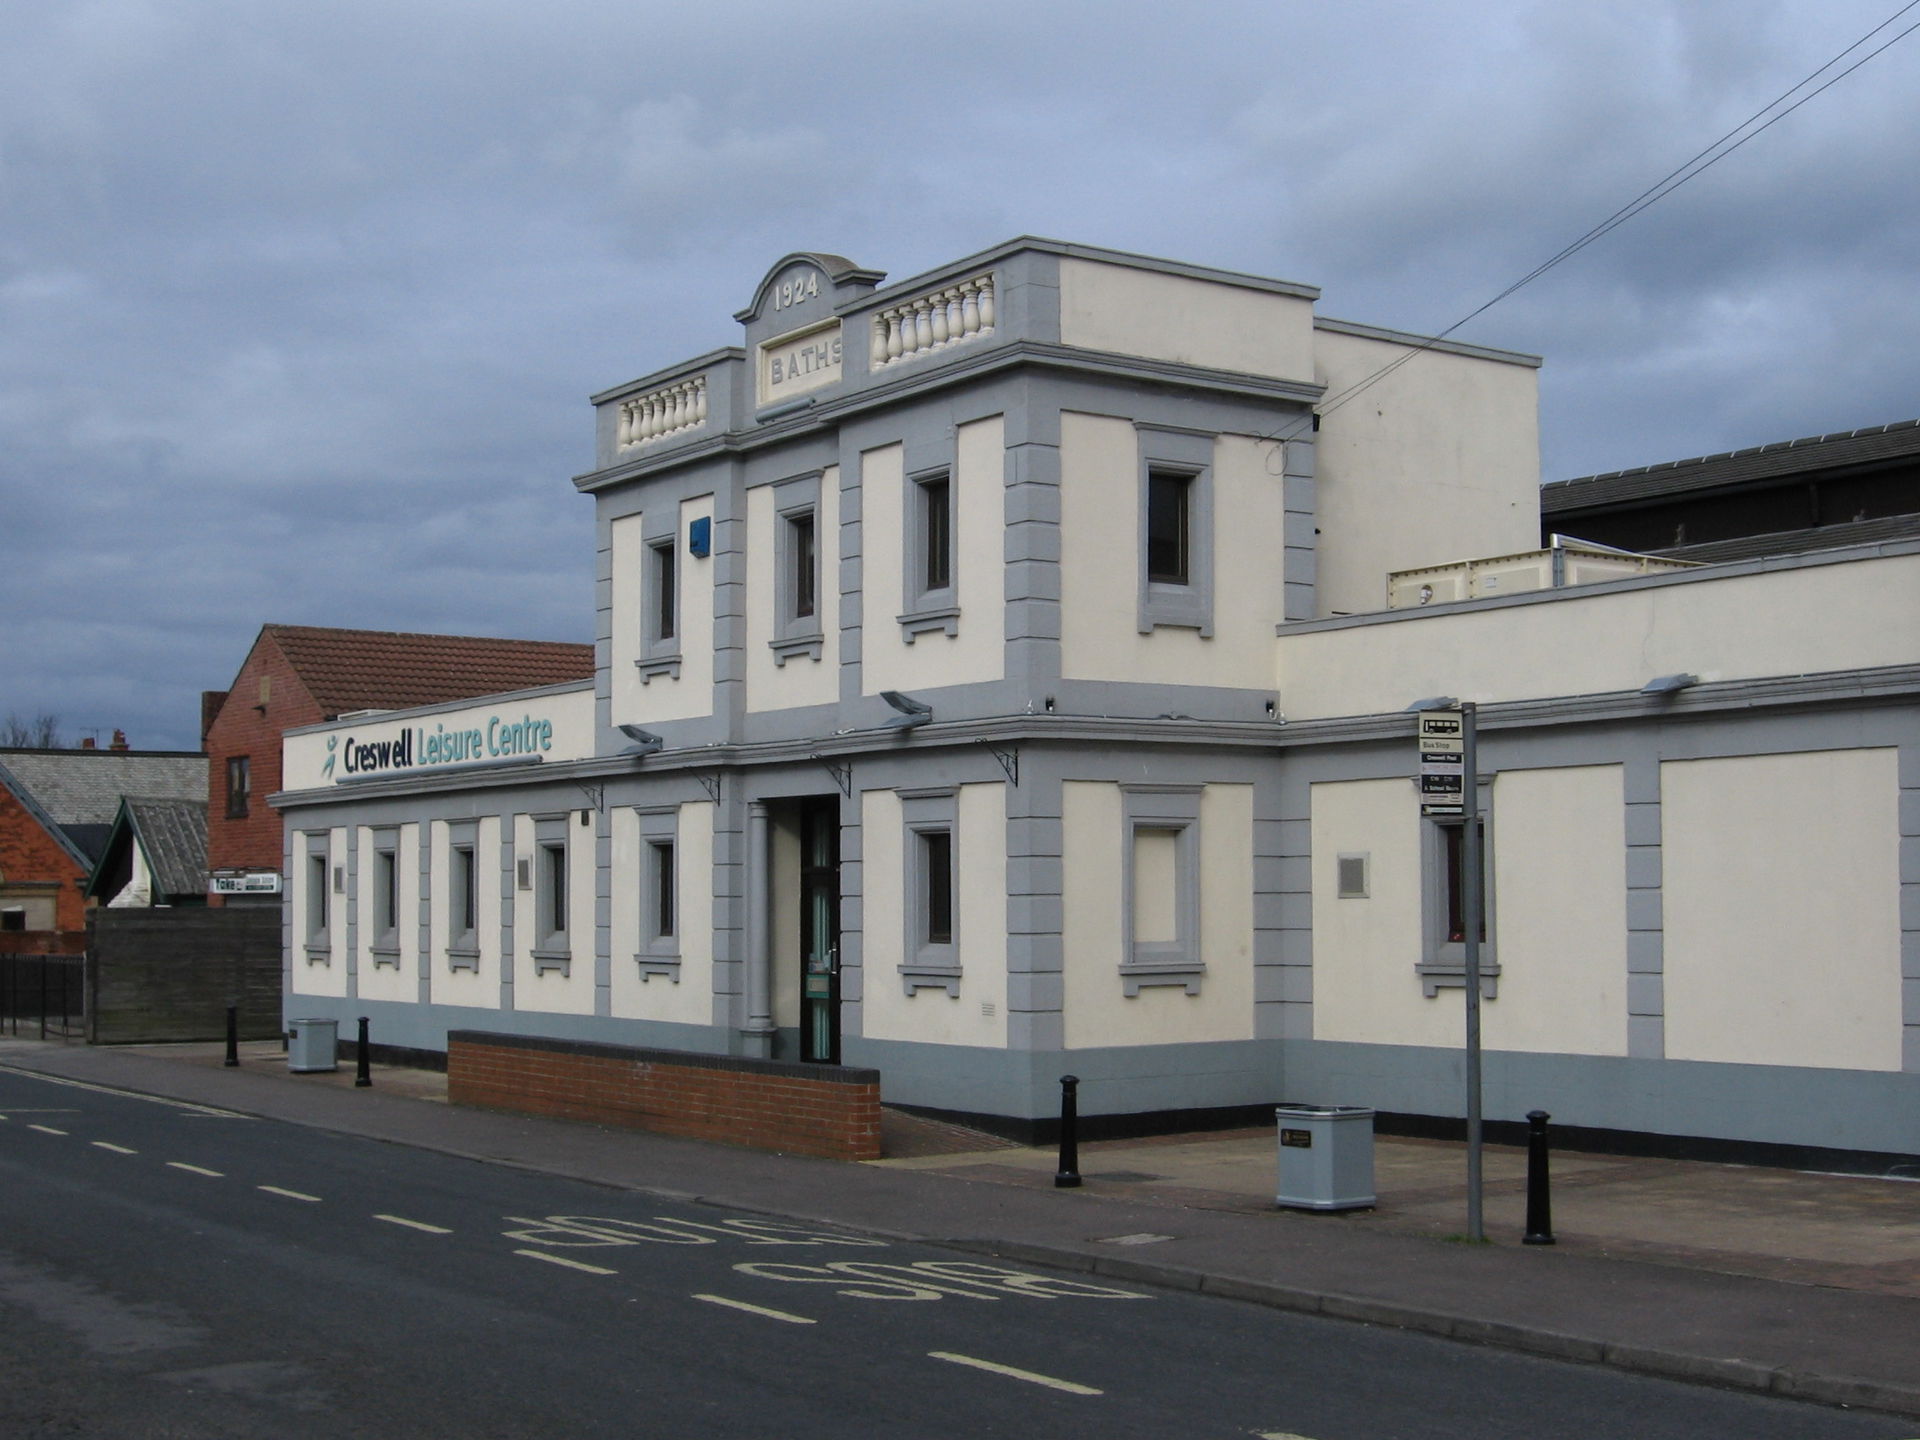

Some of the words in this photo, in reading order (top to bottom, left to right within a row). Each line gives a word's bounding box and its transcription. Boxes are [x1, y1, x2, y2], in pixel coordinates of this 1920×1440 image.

[775, 272, 818, 311] 1924
[771, 338, 841, 385] BATHS
[344, 728, 412, 773] Creswell
[417, 722, 482, 766] Leisure
[486, 713, 553, 757] Centre
[1435, 741, 1450, 749] Stop
[501, 1215, 890, 1247] STOP
[731, 1260, 1154, 1301] BUS
